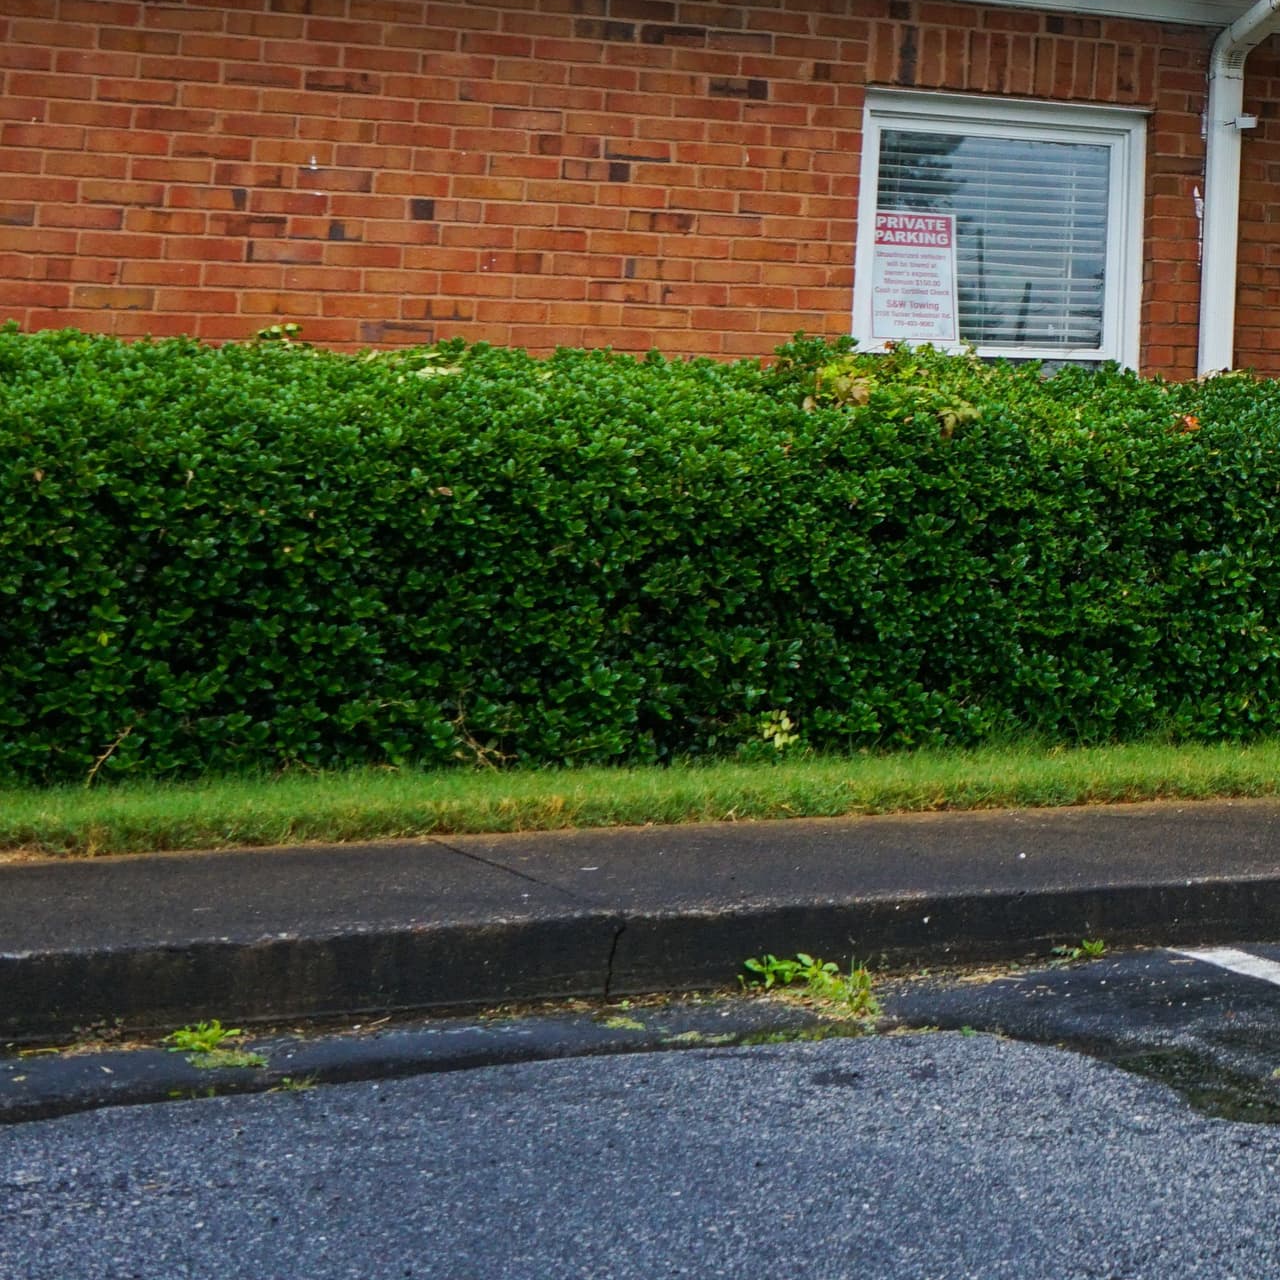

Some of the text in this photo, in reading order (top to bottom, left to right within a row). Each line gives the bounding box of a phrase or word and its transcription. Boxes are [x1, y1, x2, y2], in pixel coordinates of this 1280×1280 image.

[876, 215, 946, 231] PRIVATE
[875, 230, 949, 245] PARKING
[909, 300, 940, 311] Towing
